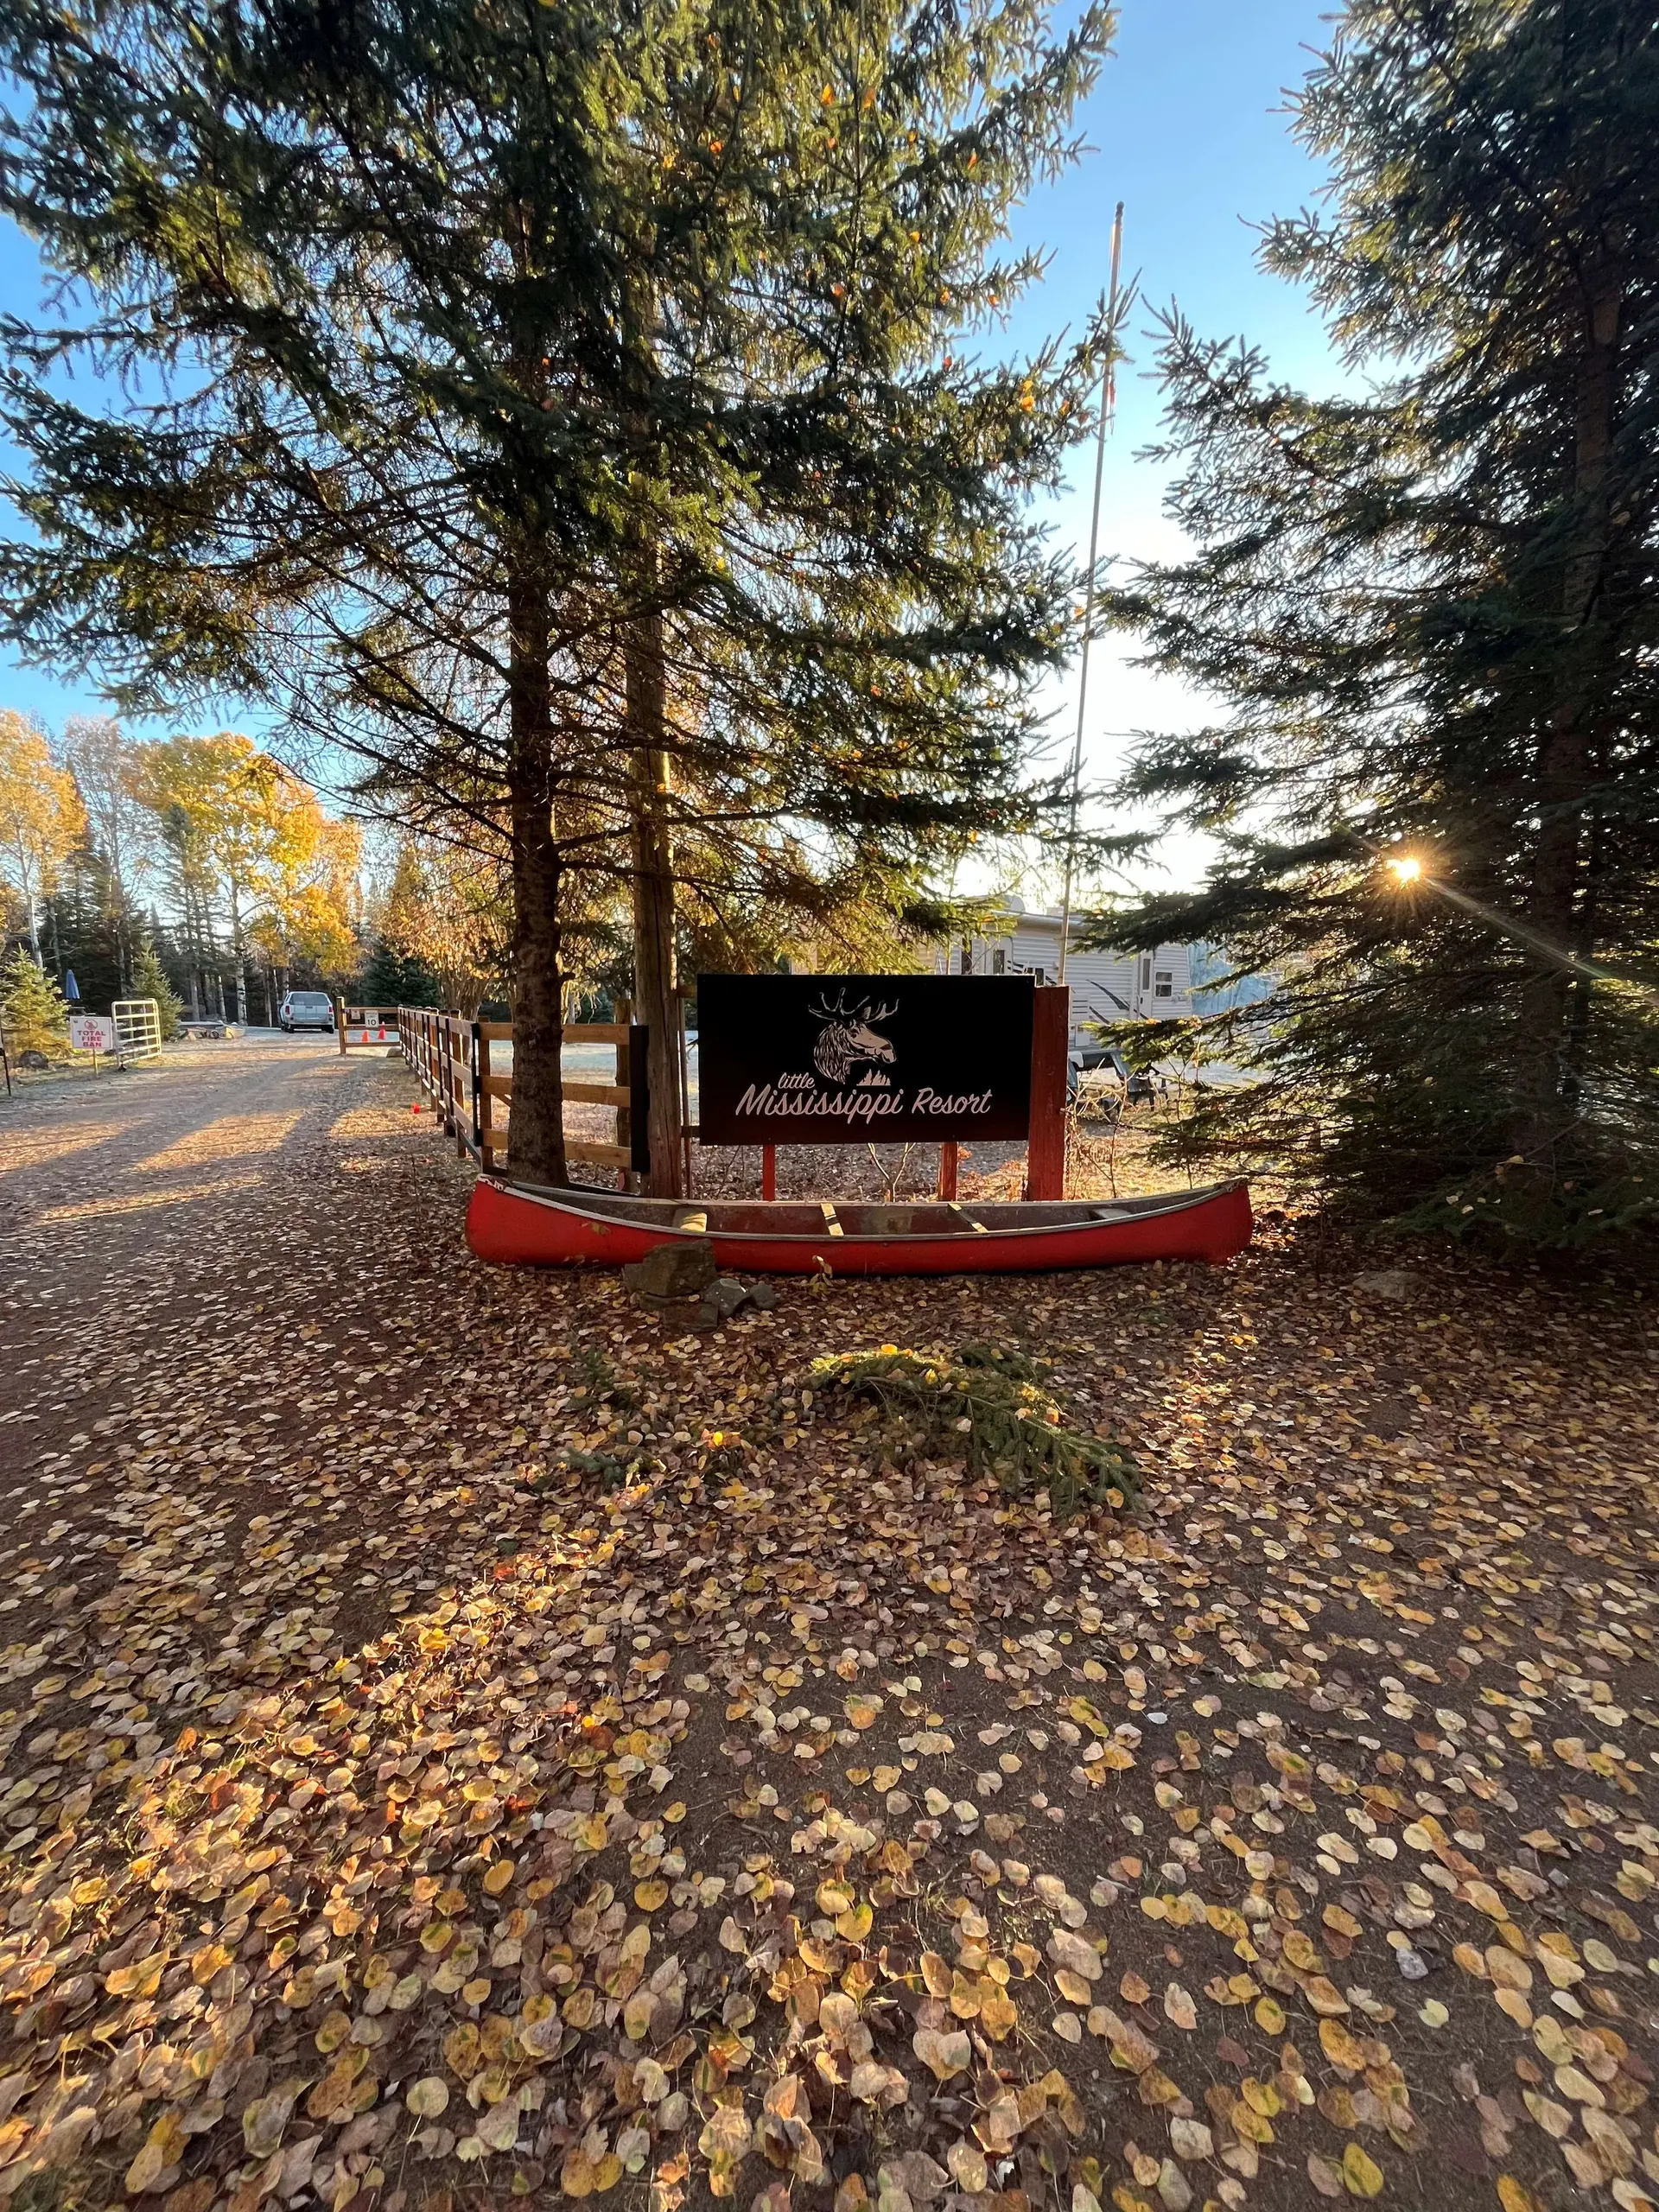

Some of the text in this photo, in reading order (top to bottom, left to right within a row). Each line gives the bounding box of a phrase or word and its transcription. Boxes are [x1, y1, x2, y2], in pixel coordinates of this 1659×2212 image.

[778, 1071, 816, 1090] little
[735, 1083, 993, 1125] Mississippi Resort
